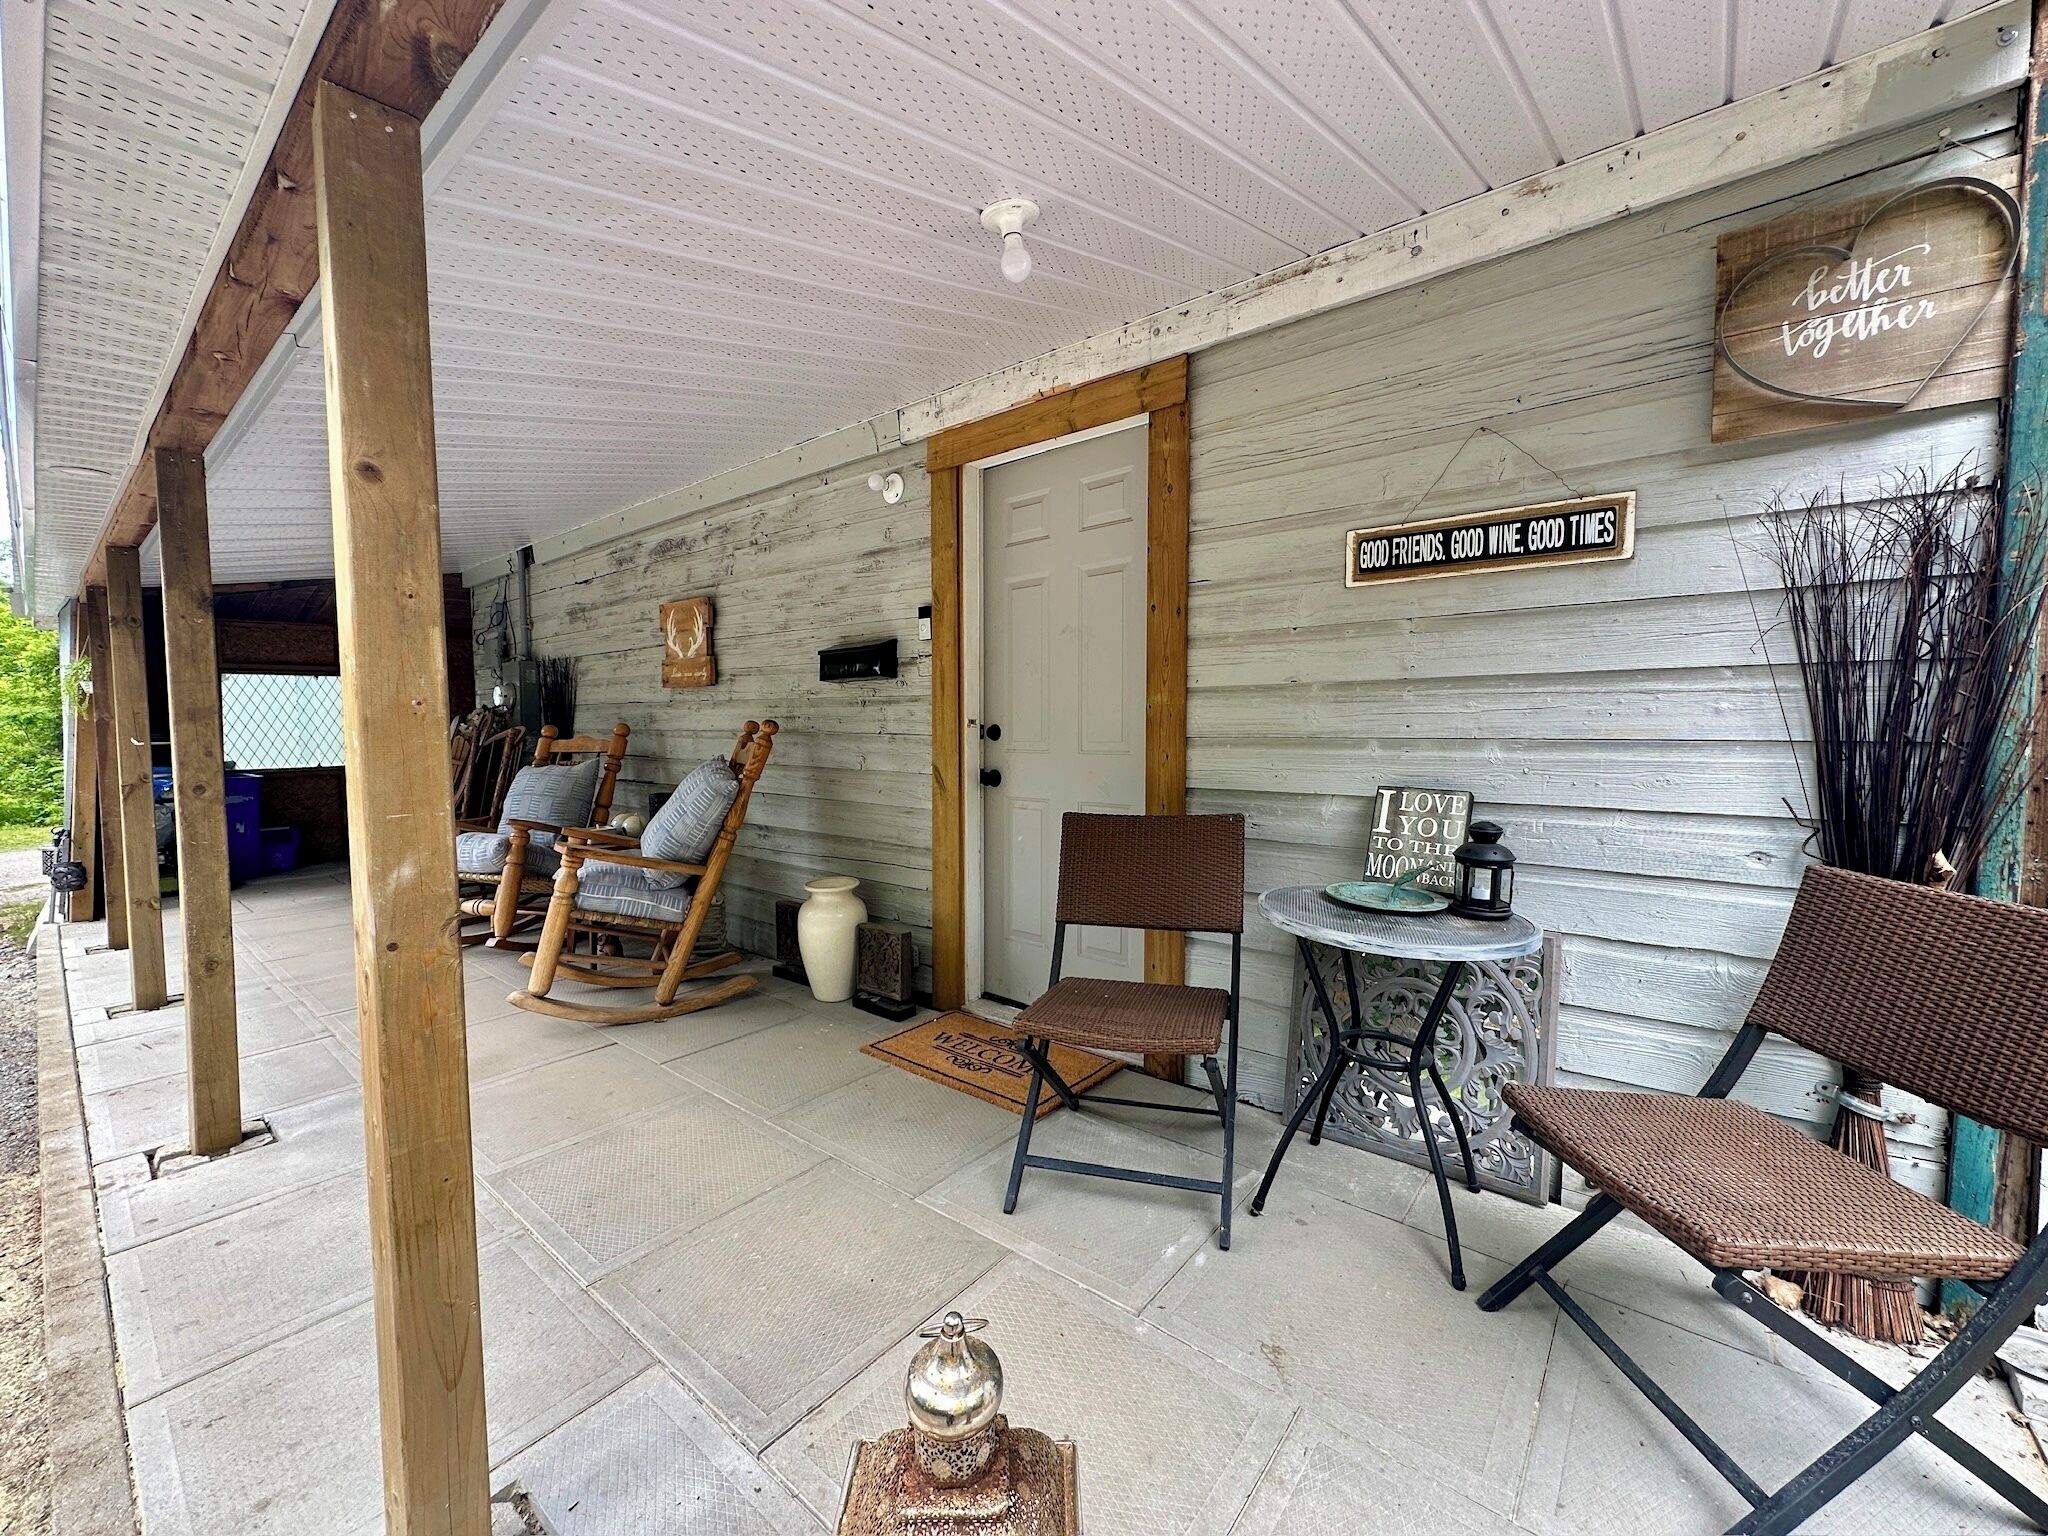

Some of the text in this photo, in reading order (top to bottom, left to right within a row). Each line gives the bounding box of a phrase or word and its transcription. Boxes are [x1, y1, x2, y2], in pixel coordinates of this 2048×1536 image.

[1792, 243, 1931, 311] better
[1770, 296, 1937, 358] together
[1360, 539, 1390, 569] GOOD
[1451, 526, 1484, 560] GOOD
[1528, 516, 1565, 551] GOOD
[1570, 510, 1615, 547] TIMES
[1372, 789, 1467, 834] I LOVE
[1399, 815, 1465, 840] YOU
[1373, 835, 1459, 857] TO THE
[1421, 872, 1456, 888] BACK
[934, 1031, 1035, 1074] WELCOM
